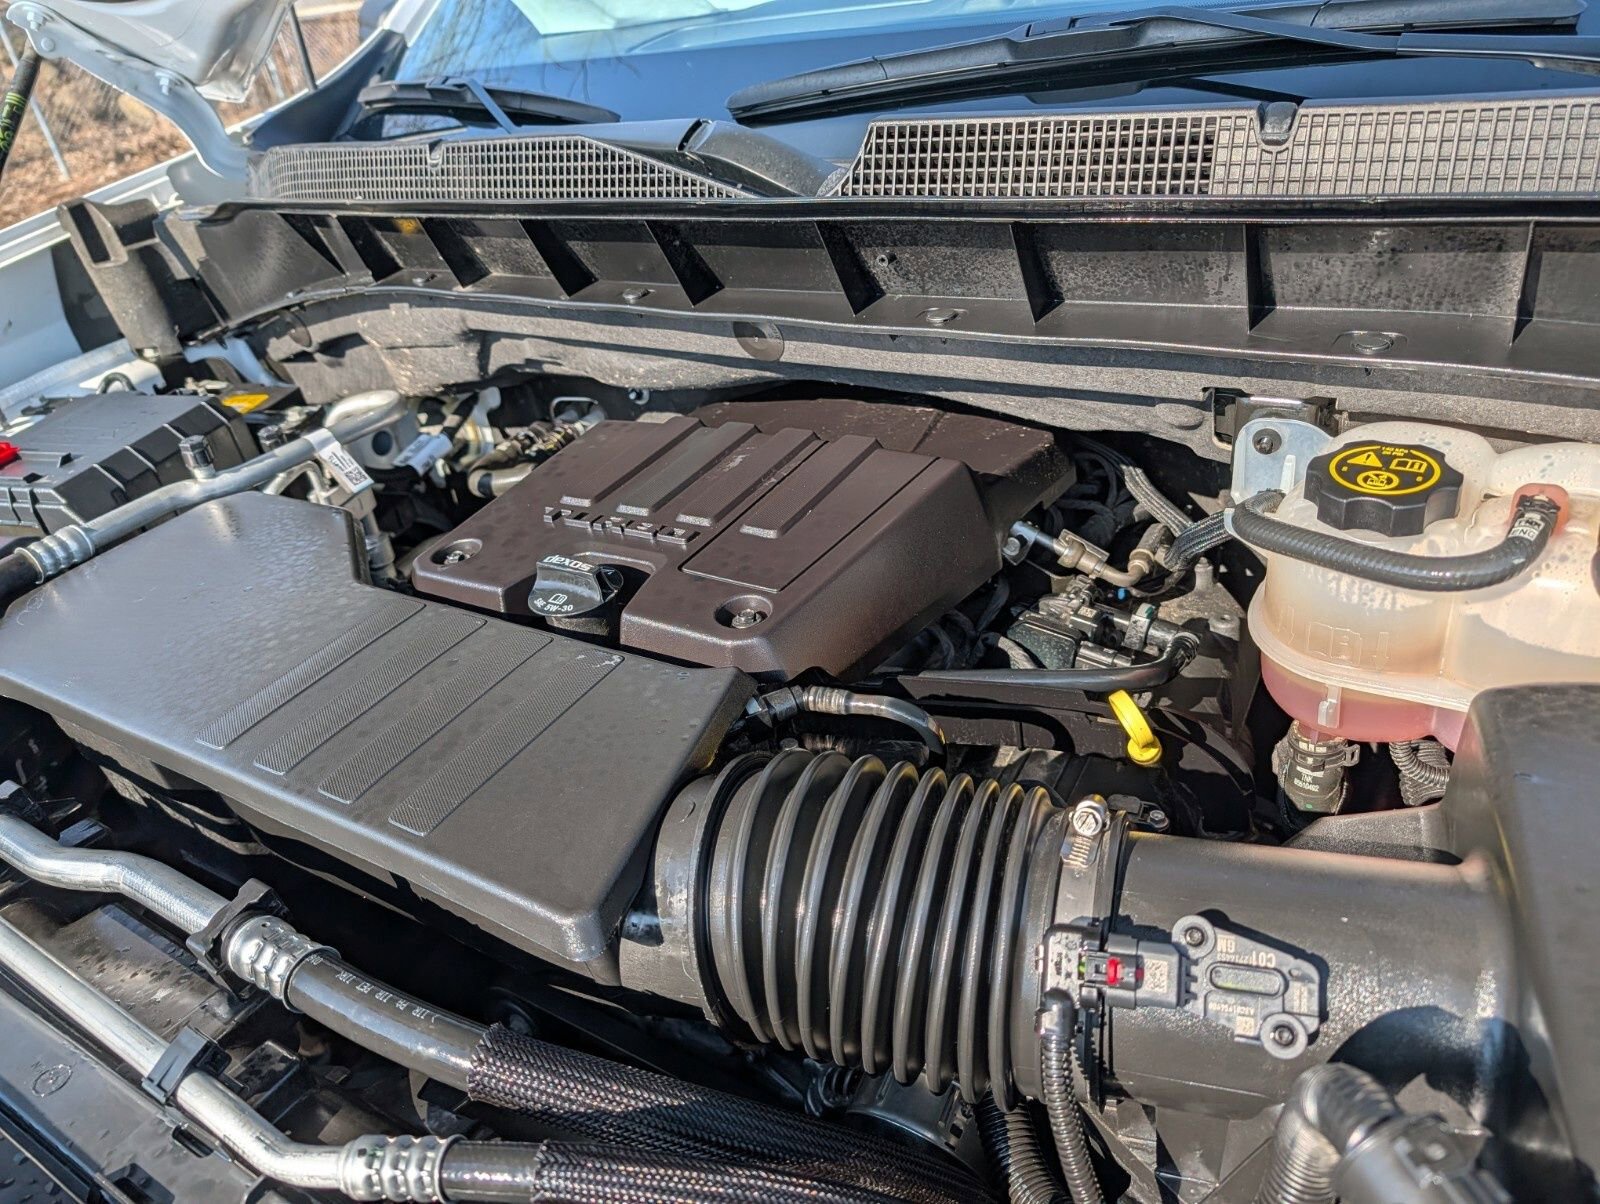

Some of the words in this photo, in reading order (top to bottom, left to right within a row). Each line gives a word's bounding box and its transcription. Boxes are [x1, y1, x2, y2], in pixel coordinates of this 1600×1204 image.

[543, 554, 595, 572] dexos
[544, 603, 574, 612] 5W-30
[1217, 938, 1236, 953] GM
